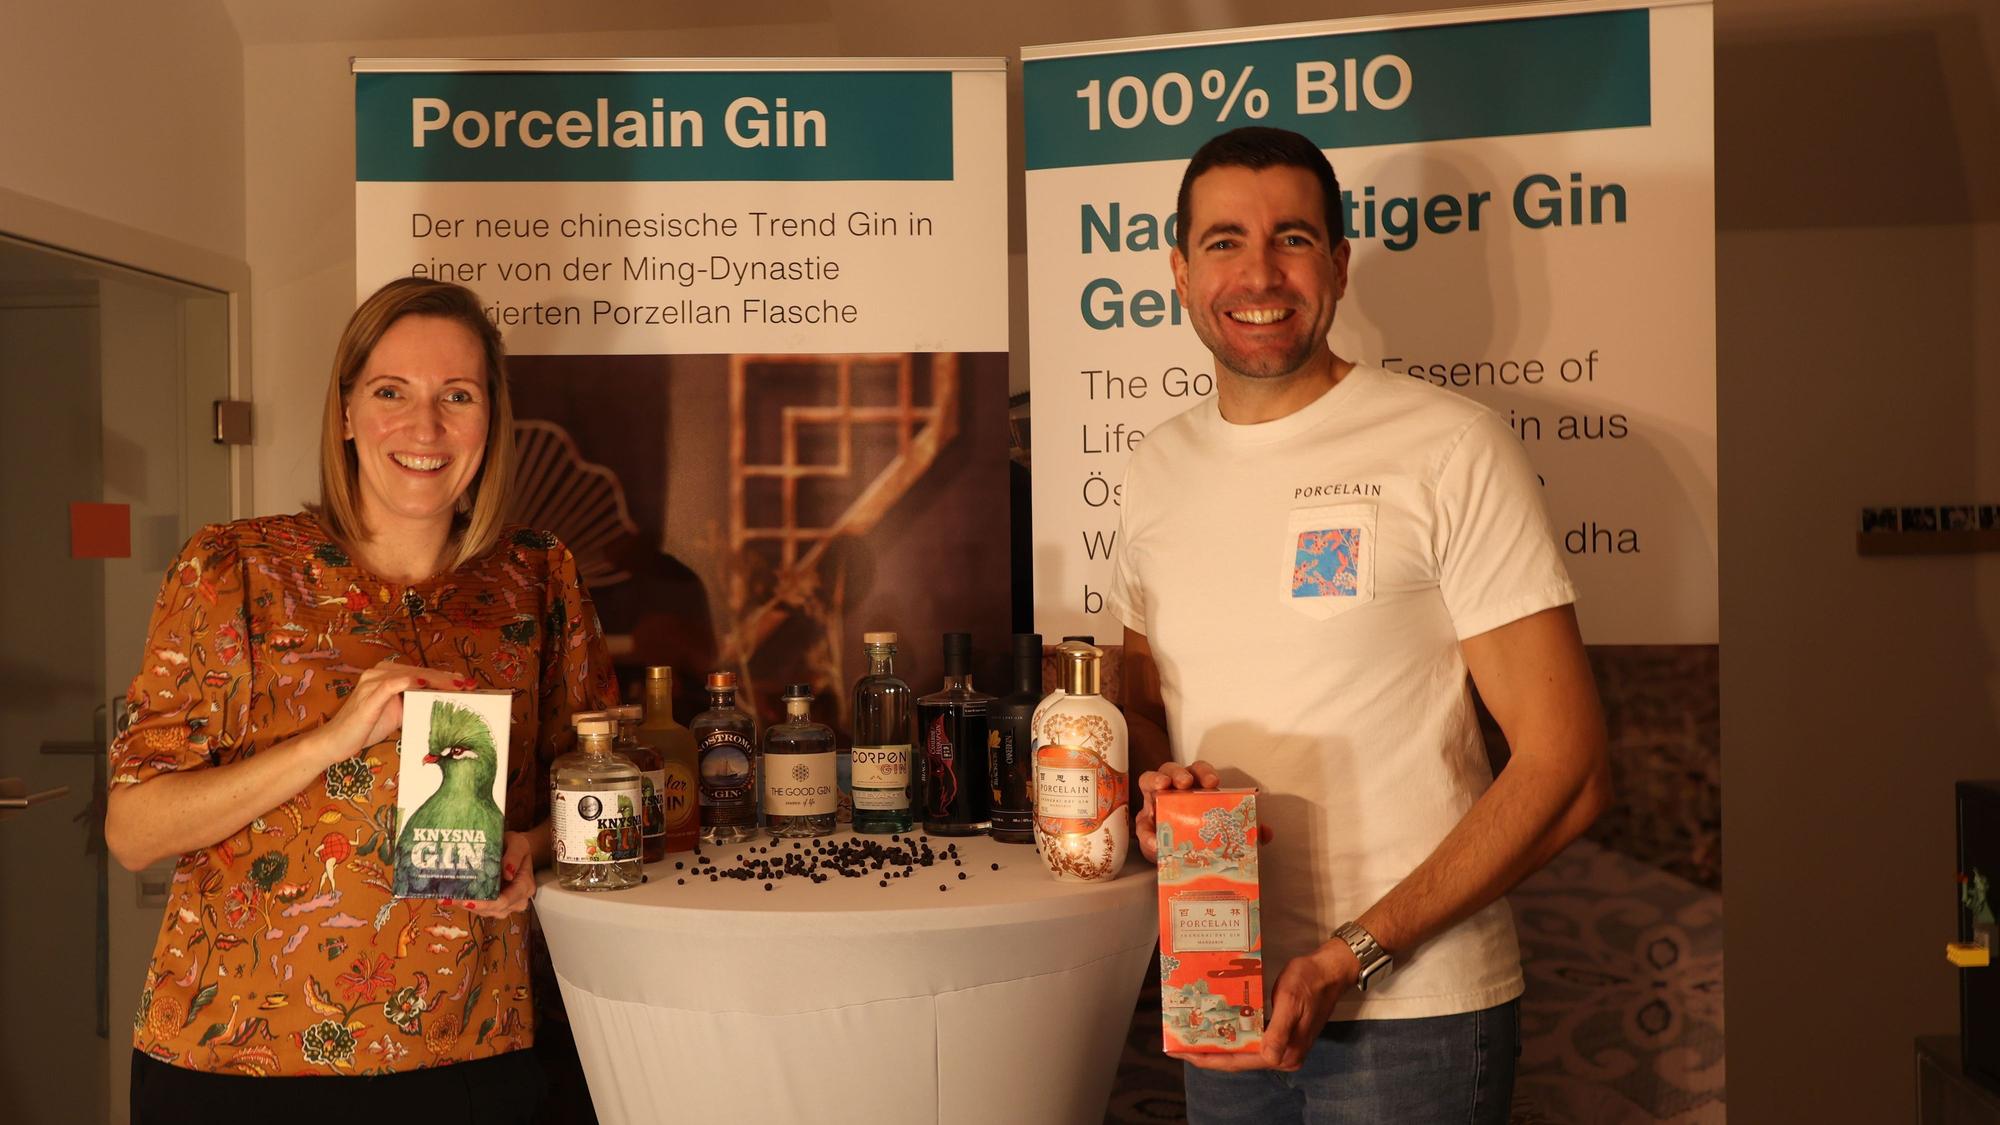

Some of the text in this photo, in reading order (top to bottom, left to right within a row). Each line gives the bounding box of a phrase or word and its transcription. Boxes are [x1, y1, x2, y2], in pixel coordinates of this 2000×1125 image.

[1077, 54, 1413, 131] 100% BIO
[412, 97, 828, 149] Porcelain Gin
[1512, 171, 1627, 230] Gin
[412, 211, 933, 239] Der neue chinesische Trend Gin in
[412, 256, 840, 288] einer von der Ming-Dynastie
[484, 299, 858, 326] rierten Porzellan Flasche
[1081, 370, 1148, 400] The
[1162, 366, 1213, 397] Go
[1560, 350, 1599, 383] of
[1083, 423, 1146, 454] Life
[1558, 414, 1629, 441] aus
[1294, 483, 1382, 499] PORCELAIN
[698, 733, 752, 754] OSTROMO
[771, 785, 831, 796] THE GOOD GIN
[1040, 784, 1089, 794] PORCELAIN
[413, 827, 487, 843] KNYSNA
[410, 842, 485, 871] GIN
[1180, 919, 1241, 929] PORCELAIN
